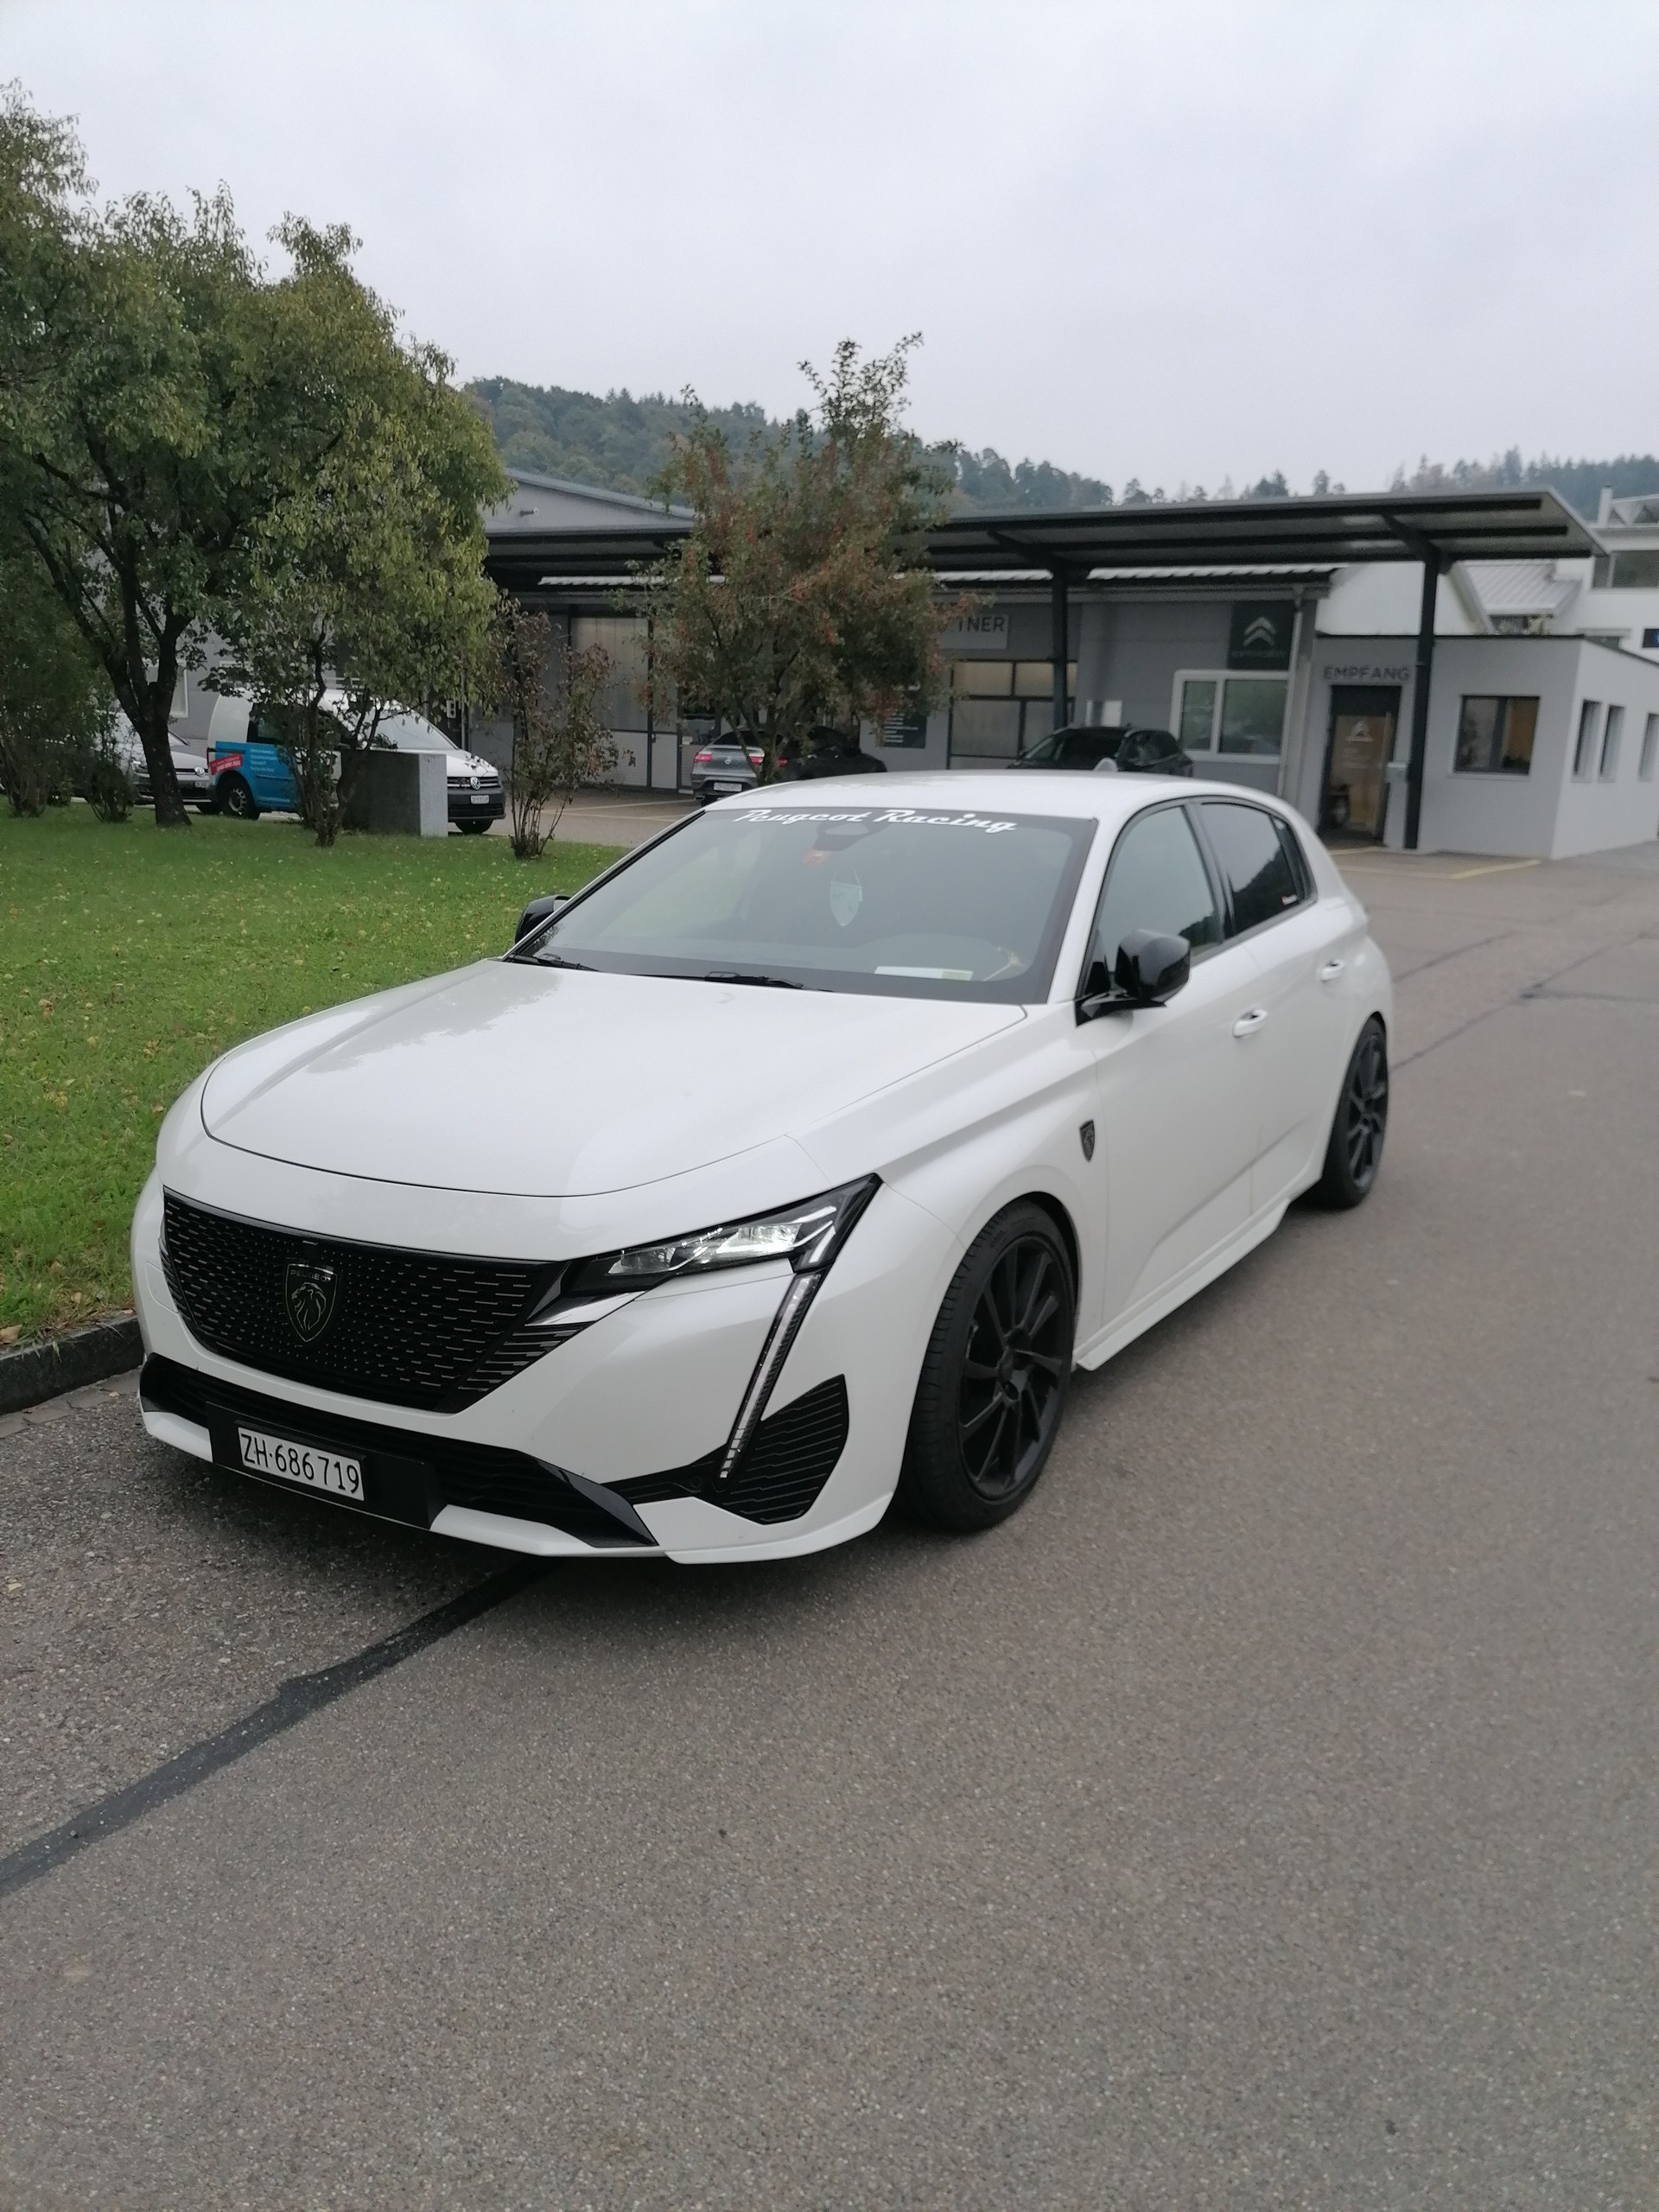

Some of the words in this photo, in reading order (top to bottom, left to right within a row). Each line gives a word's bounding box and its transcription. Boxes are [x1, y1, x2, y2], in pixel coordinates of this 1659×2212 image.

[1322, 664, 1410, 682] EMPFANG
[734, 809, 873, 825] Peugeot
[873, 809, 1018, 834] Racing
